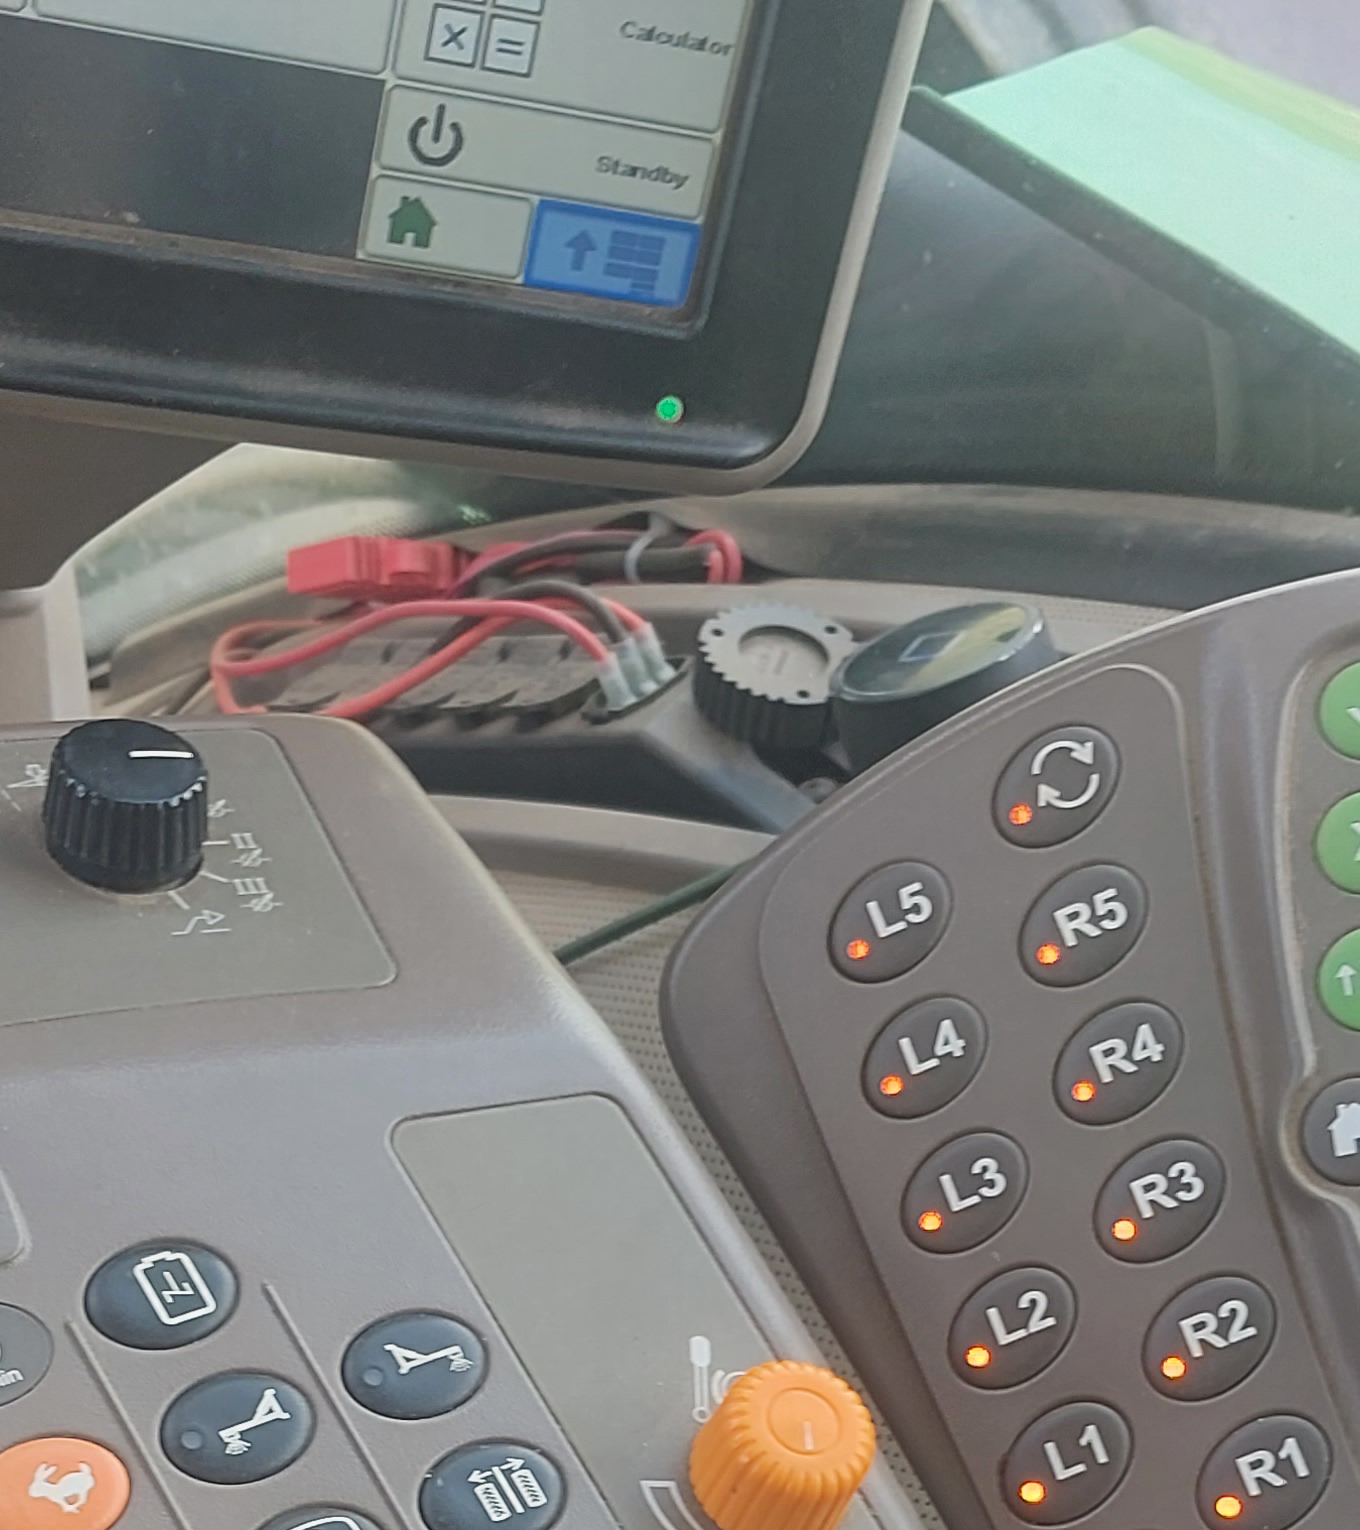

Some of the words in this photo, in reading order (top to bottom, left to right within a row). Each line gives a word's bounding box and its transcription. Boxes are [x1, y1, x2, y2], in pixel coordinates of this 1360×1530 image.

[619, 20, 735, 57] Calculator
[596, 156, 691, 190] Standby
[866, 882, 933, 938] L5
[1053, 888, 1128, 947] R5
[898, 1019, 966, 1075] L4
[1089, 1024, 1165, 1083] R4
[939, 1157, 1008, 1212] L3
[1129, 1161, 1205, 1219] R3
[986, 1290, 1057, 1346] L2
[1178, 1299, 1258, 1358] R2
[1043, 1424, 1110, 1481] L1
[1235, 1437, 1311, 1497] R1
